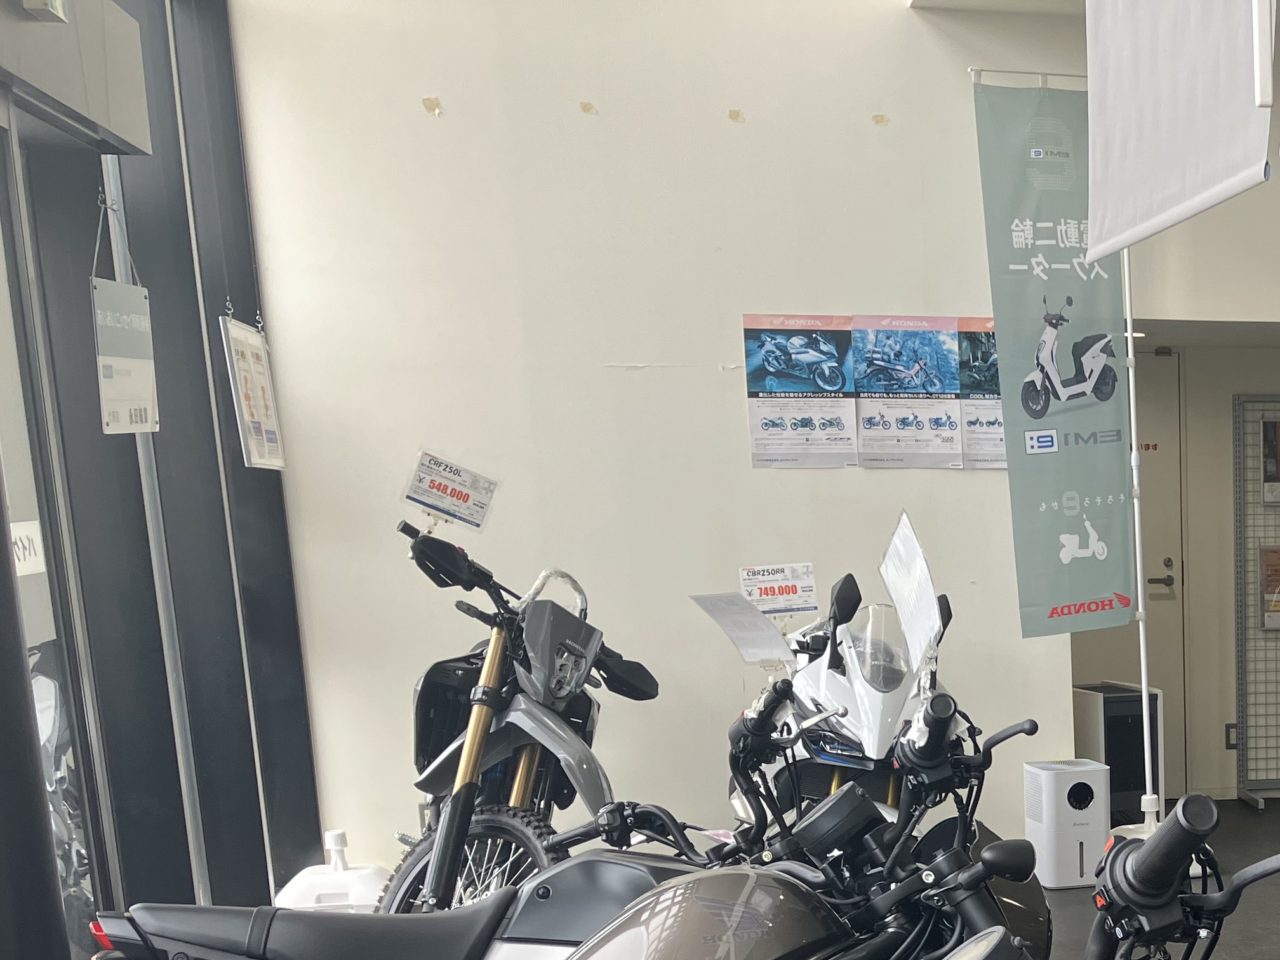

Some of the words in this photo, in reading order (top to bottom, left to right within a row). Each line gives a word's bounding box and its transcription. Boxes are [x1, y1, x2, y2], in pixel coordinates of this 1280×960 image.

[784, 318, 822, 326] HONDA
[891, 320, 928, 328] HONDA
[428, 458, 463, 477] CRF250L
[746, 568, 785, 577] CBR250RR
